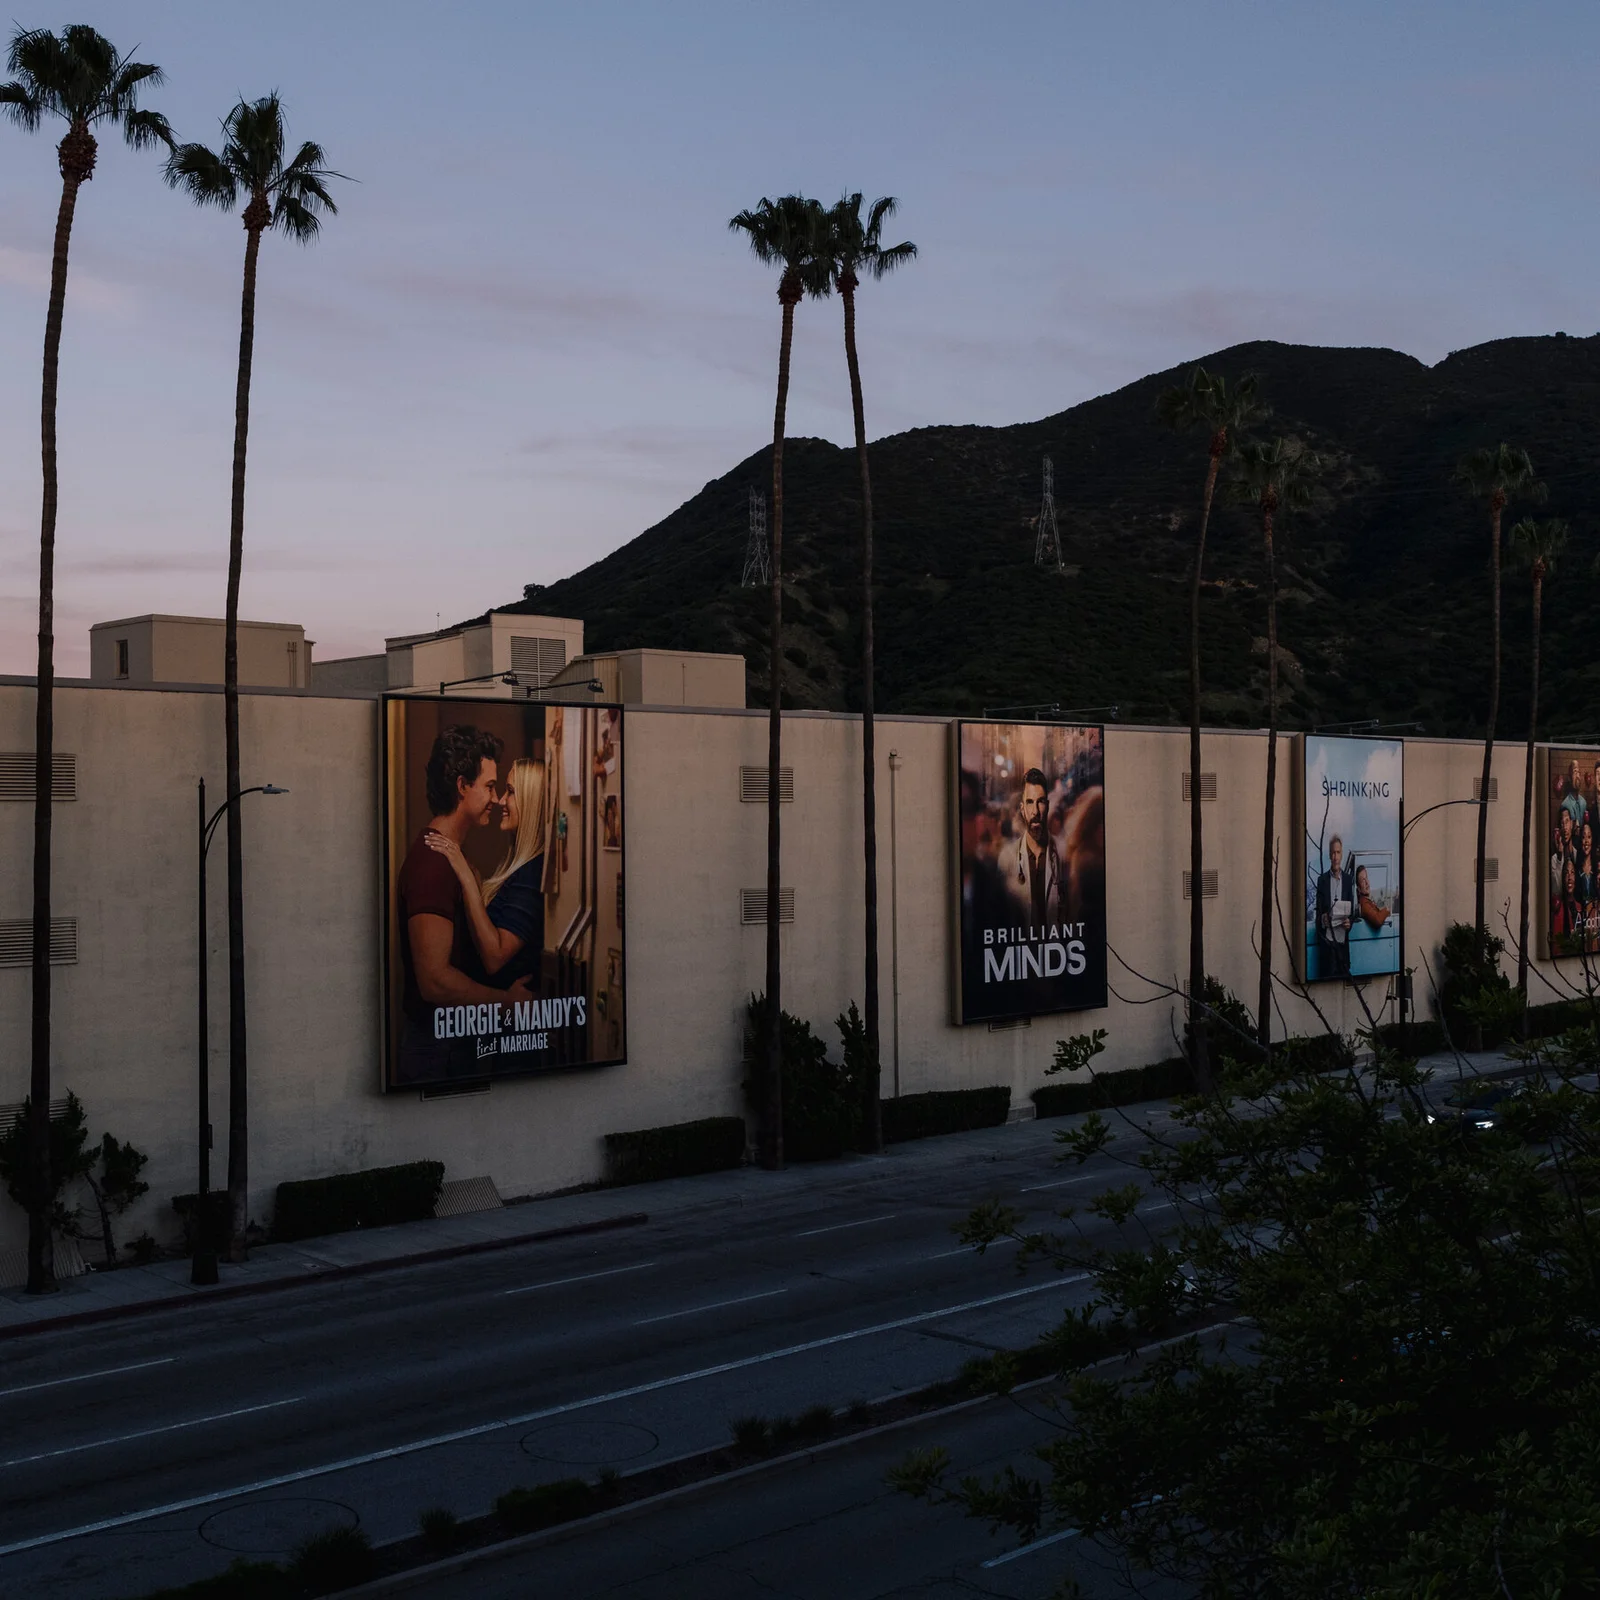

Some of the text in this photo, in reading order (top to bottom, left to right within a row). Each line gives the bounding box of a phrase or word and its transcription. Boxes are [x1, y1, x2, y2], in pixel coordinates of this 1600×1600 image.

[983, 922, 1086, 945] BRILLIANT
[983, 939, 1087, 984] MINDS
[433, 995, 587, 1040] GEORGIE & MANDY'S
[476, 1032, 549, 1059] first MARRIAGE
